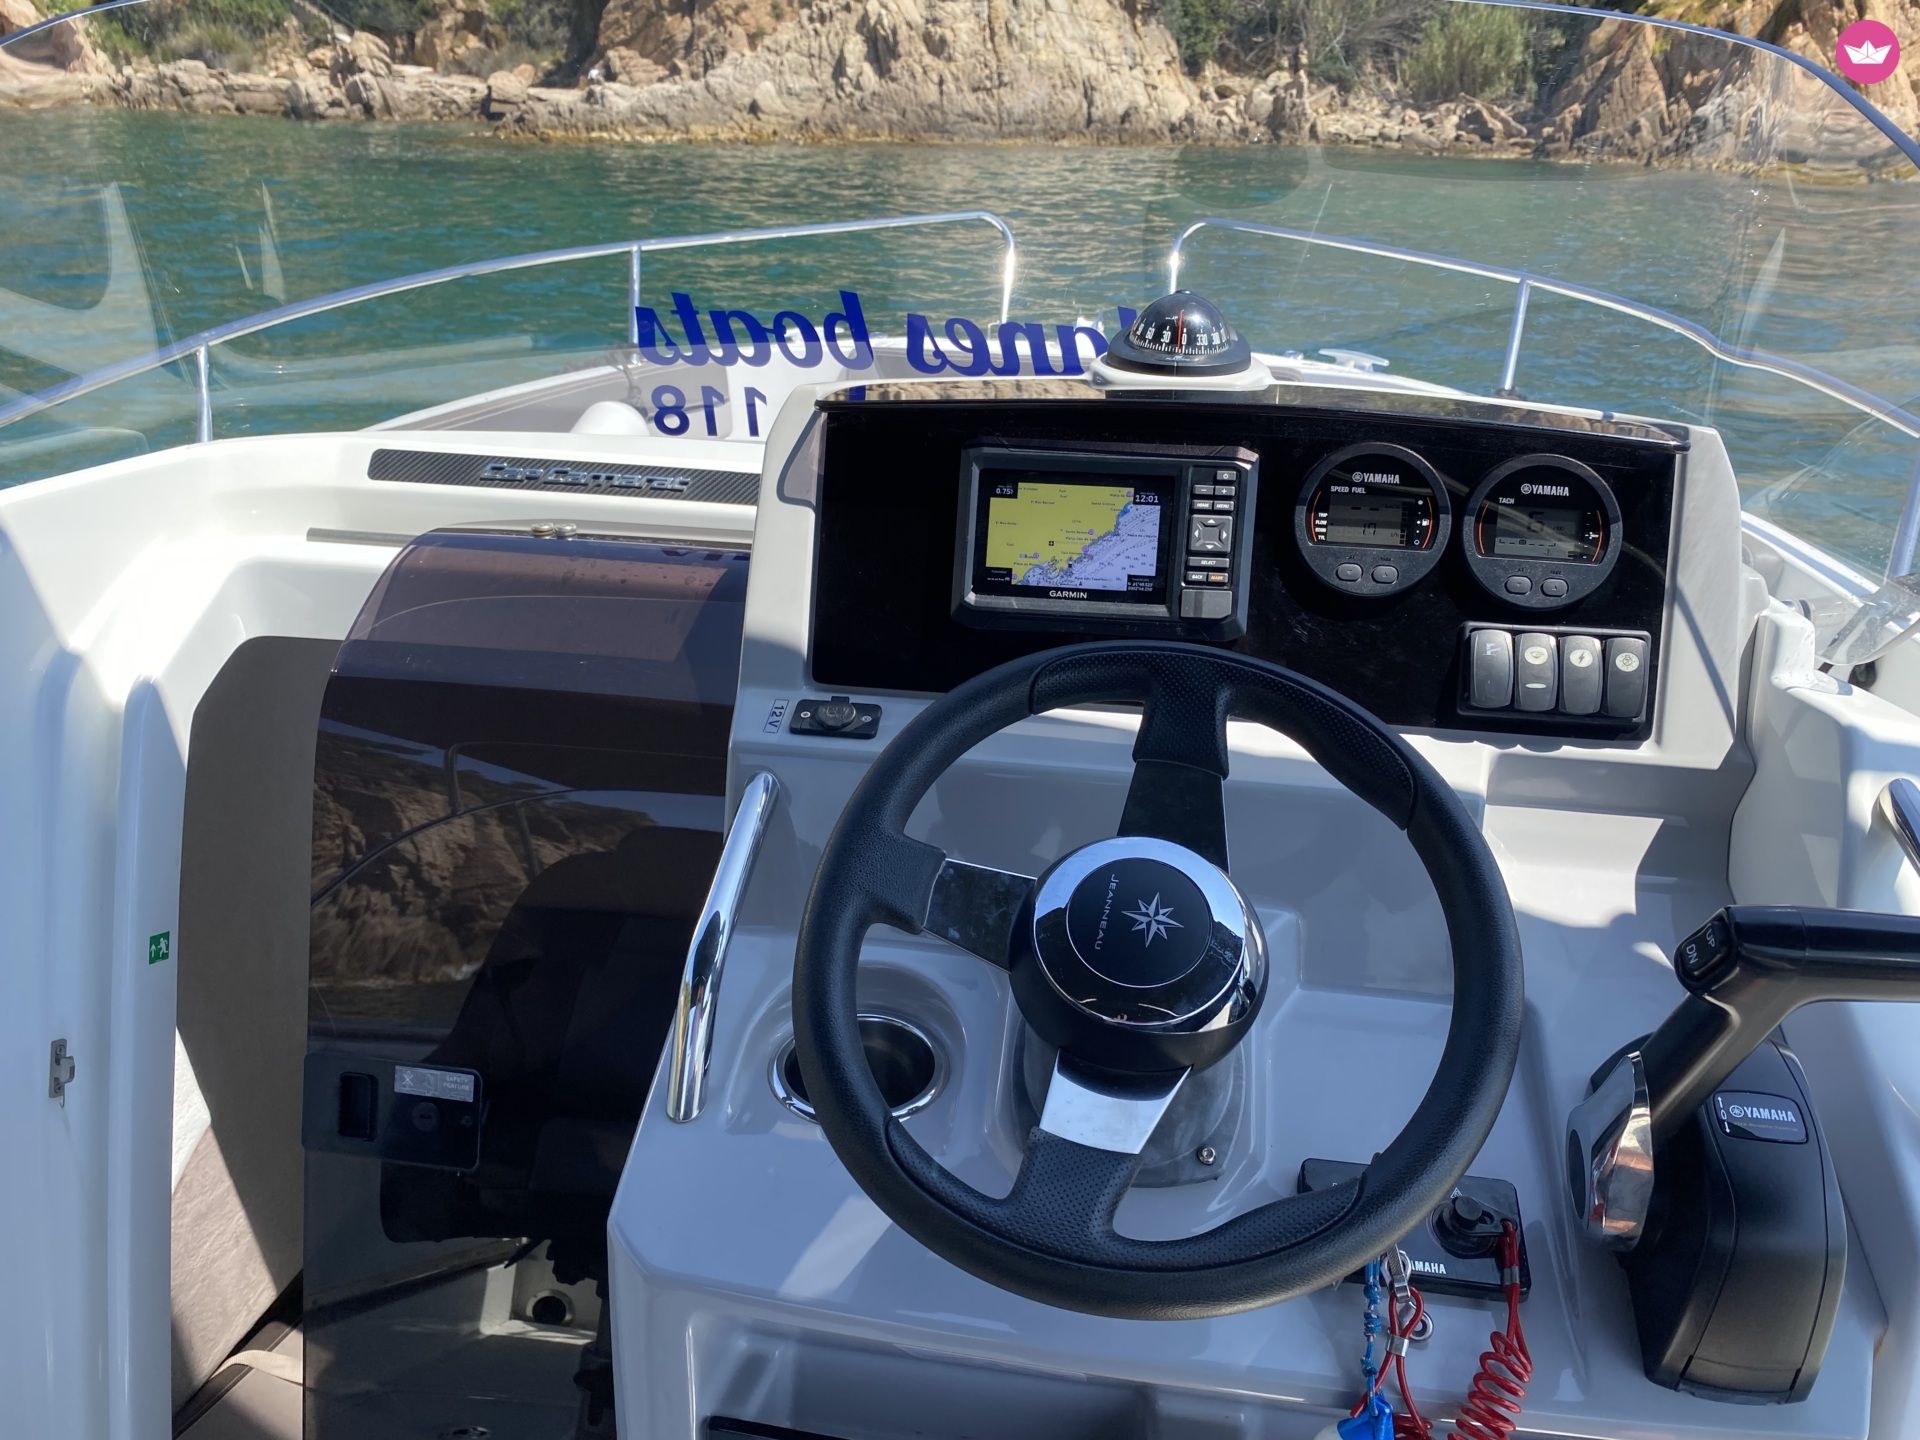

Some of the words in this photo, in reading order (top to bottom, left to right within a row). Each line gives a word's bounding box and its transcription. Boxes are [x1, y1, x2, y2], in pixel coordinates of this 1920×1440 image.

[1145, 327, 1156, 340] 60
[1160, 330, 1171, 343] 30
[1181, 333, 1188, 346] 0
[1196, 333, 1209, 346] 330
[480, 462, 544, 482] Cap
[543, 466, 691, 493] Camarat
[1363, 472, 1400, 484] YAMAHA
[1330, 485, 1350, 493] SPEED
[1351, 486, 1367, 494] FUEL
[1532, 484, 1570, 497] YAMAHA
[1135, 494, 1160, 503] 12:01
[1049, 590, 1088, 599] GARMIN
[1094, 873, 1120, 951] JEANNEAU
[1705, 929, 1716, 949] UP
[1686, 943, 1698, 965] DN
[1743, 1106, 1797, 1123] YAMAHA
